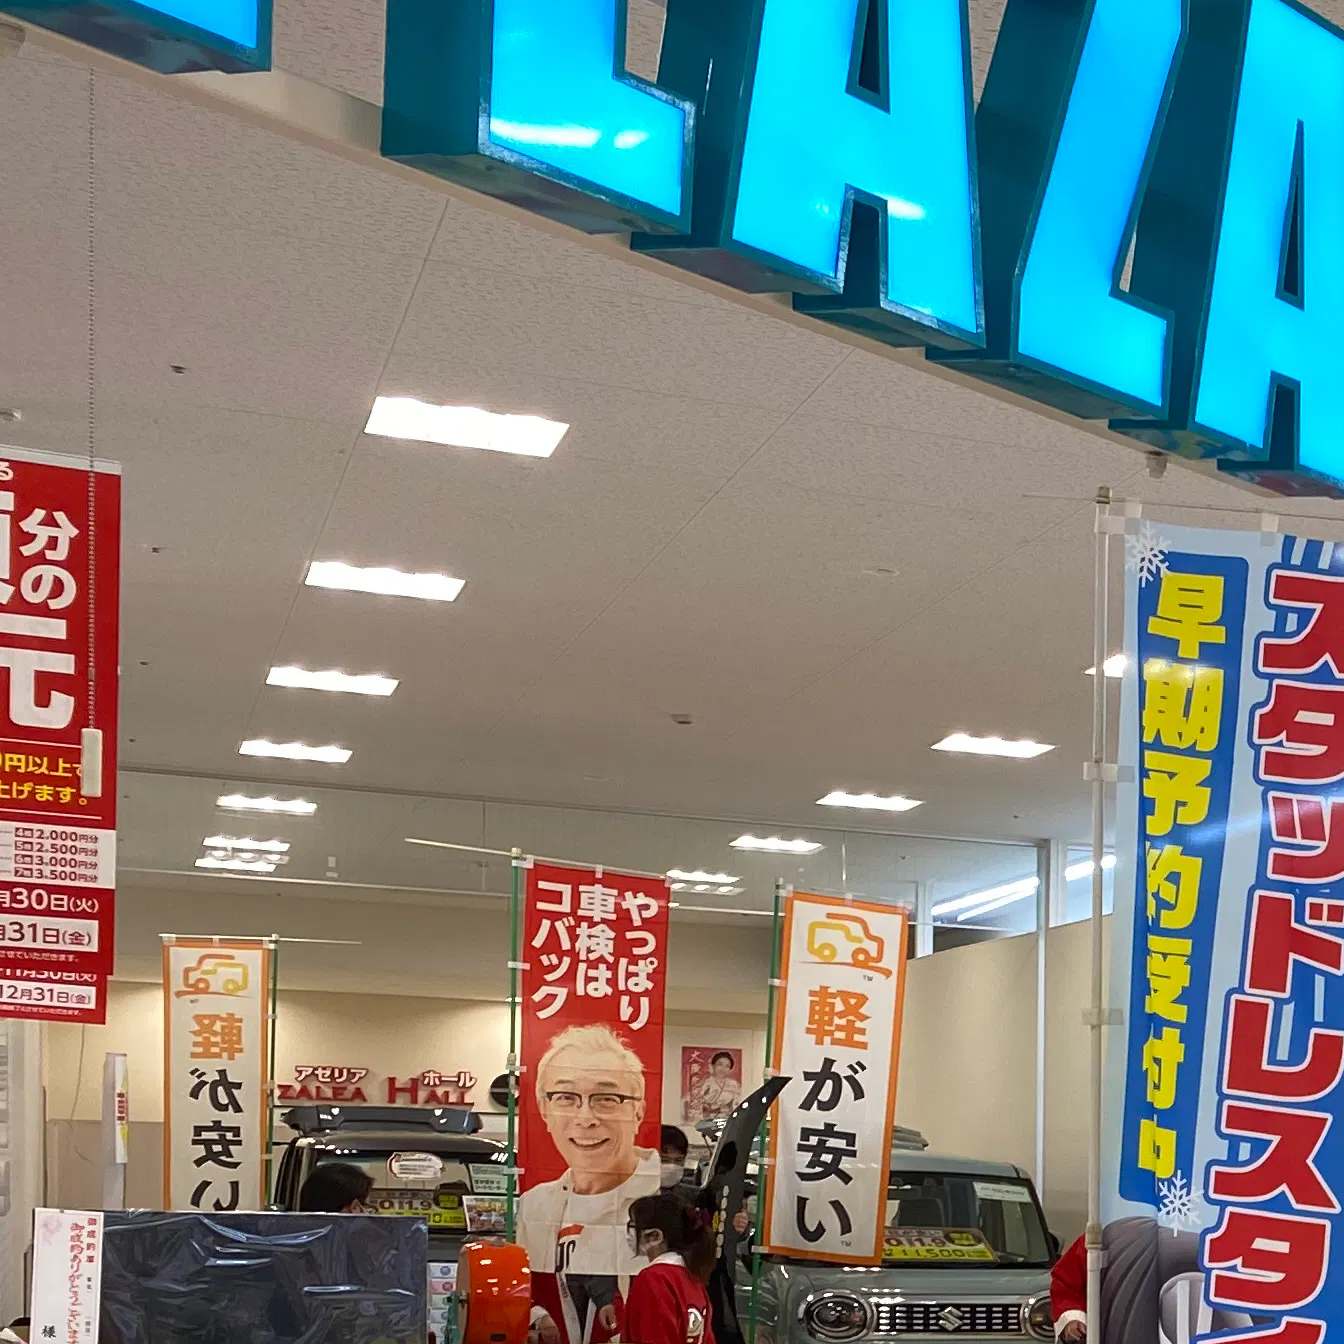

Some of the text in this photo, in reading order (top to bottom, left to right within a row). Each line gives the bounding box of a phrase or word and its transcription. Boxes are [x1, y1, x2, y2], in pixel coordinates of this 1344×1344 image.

[0, 920, 92, 947] 31日(金)
[531, 879, 573, 1020] コバック
[576, 884, 615, 998] 車検は
[618, 889, 660, 1031] やっぱり
[277, 1083, 369, 1103] ZALEA
[295, 1066, 477, 1088] アゼリア ホール
[796, 985, 872, 1246] 軽が安い
